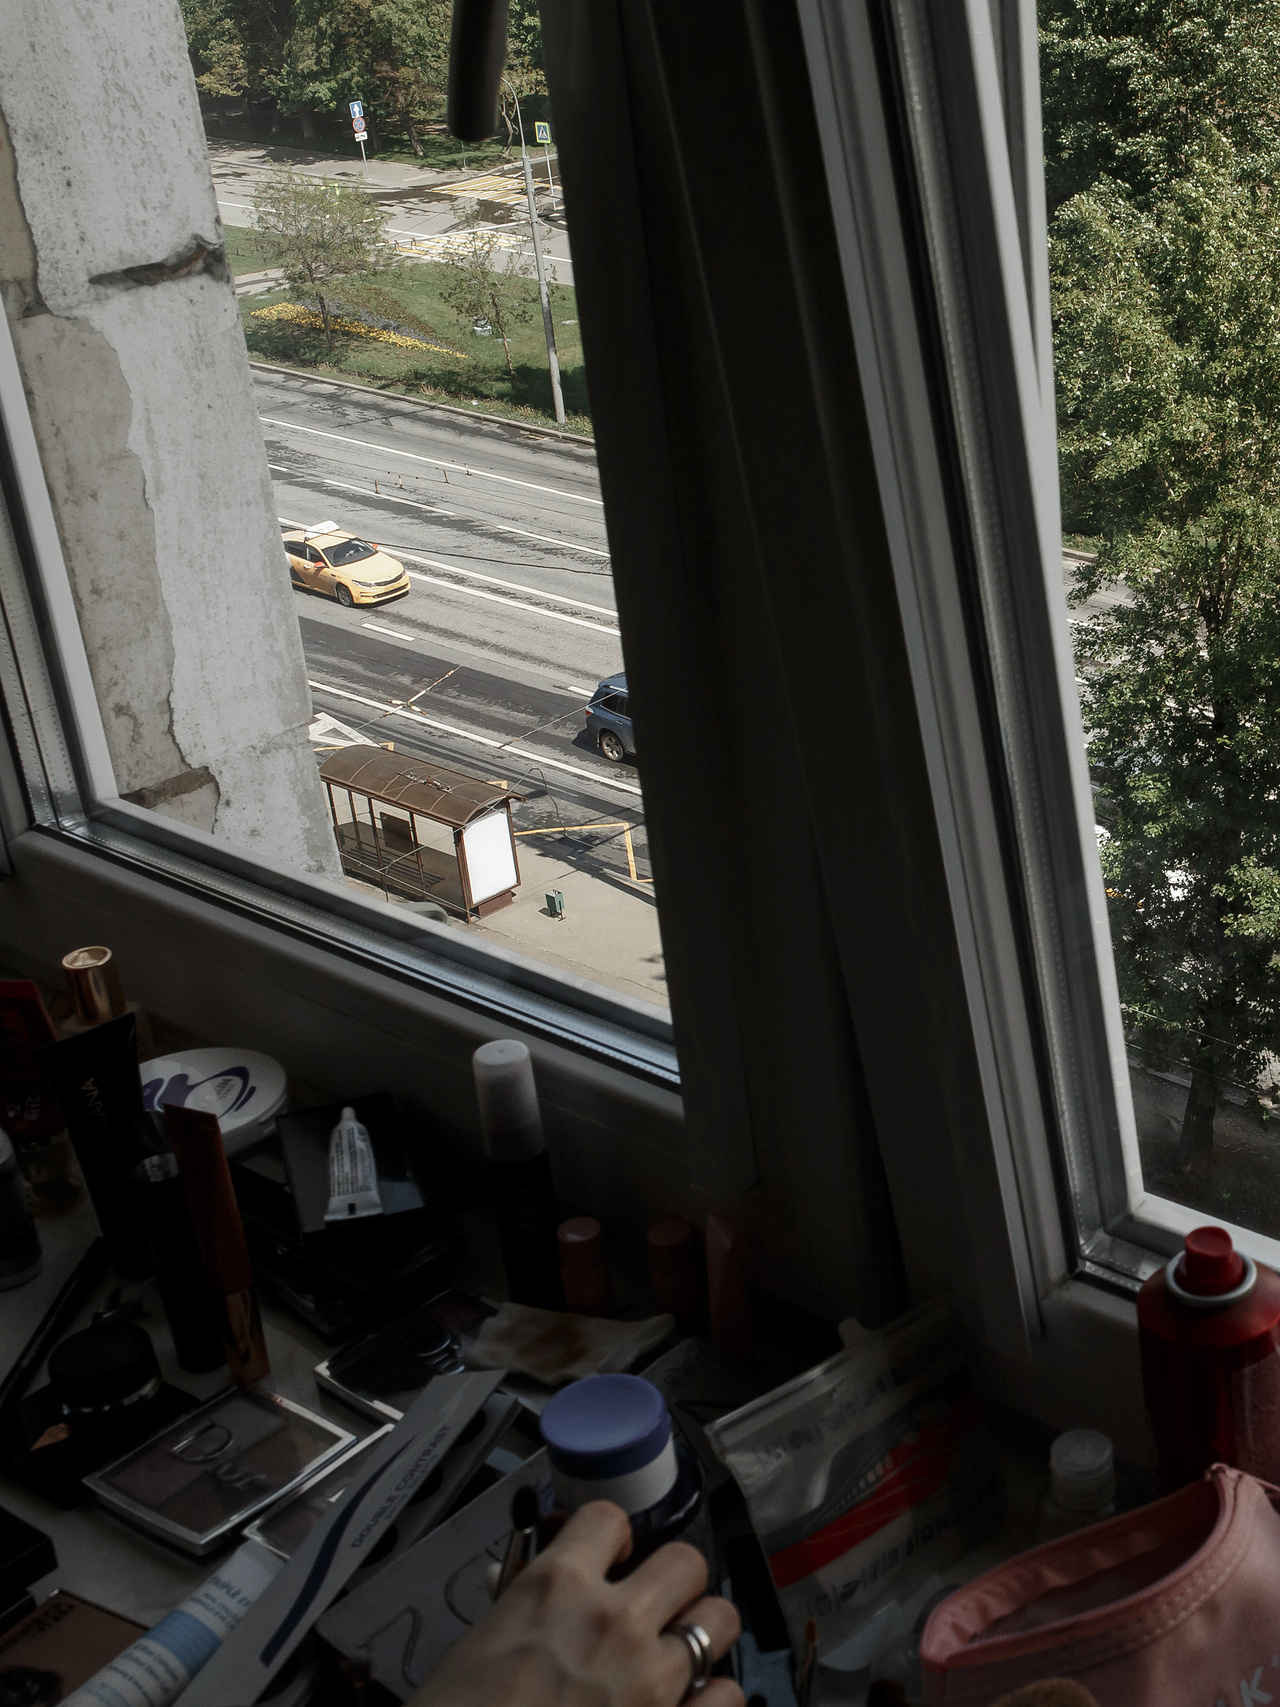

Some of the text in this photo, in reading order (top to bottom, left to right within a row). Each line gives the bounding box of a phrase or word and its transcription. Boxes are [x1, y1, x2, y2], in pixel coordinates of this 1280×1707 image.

[172, 1421, 268, 1491] Dior
[350, 1494, 398, 1548] DOUBLE
[395, 1425, 452, 1492] CONTRAST
